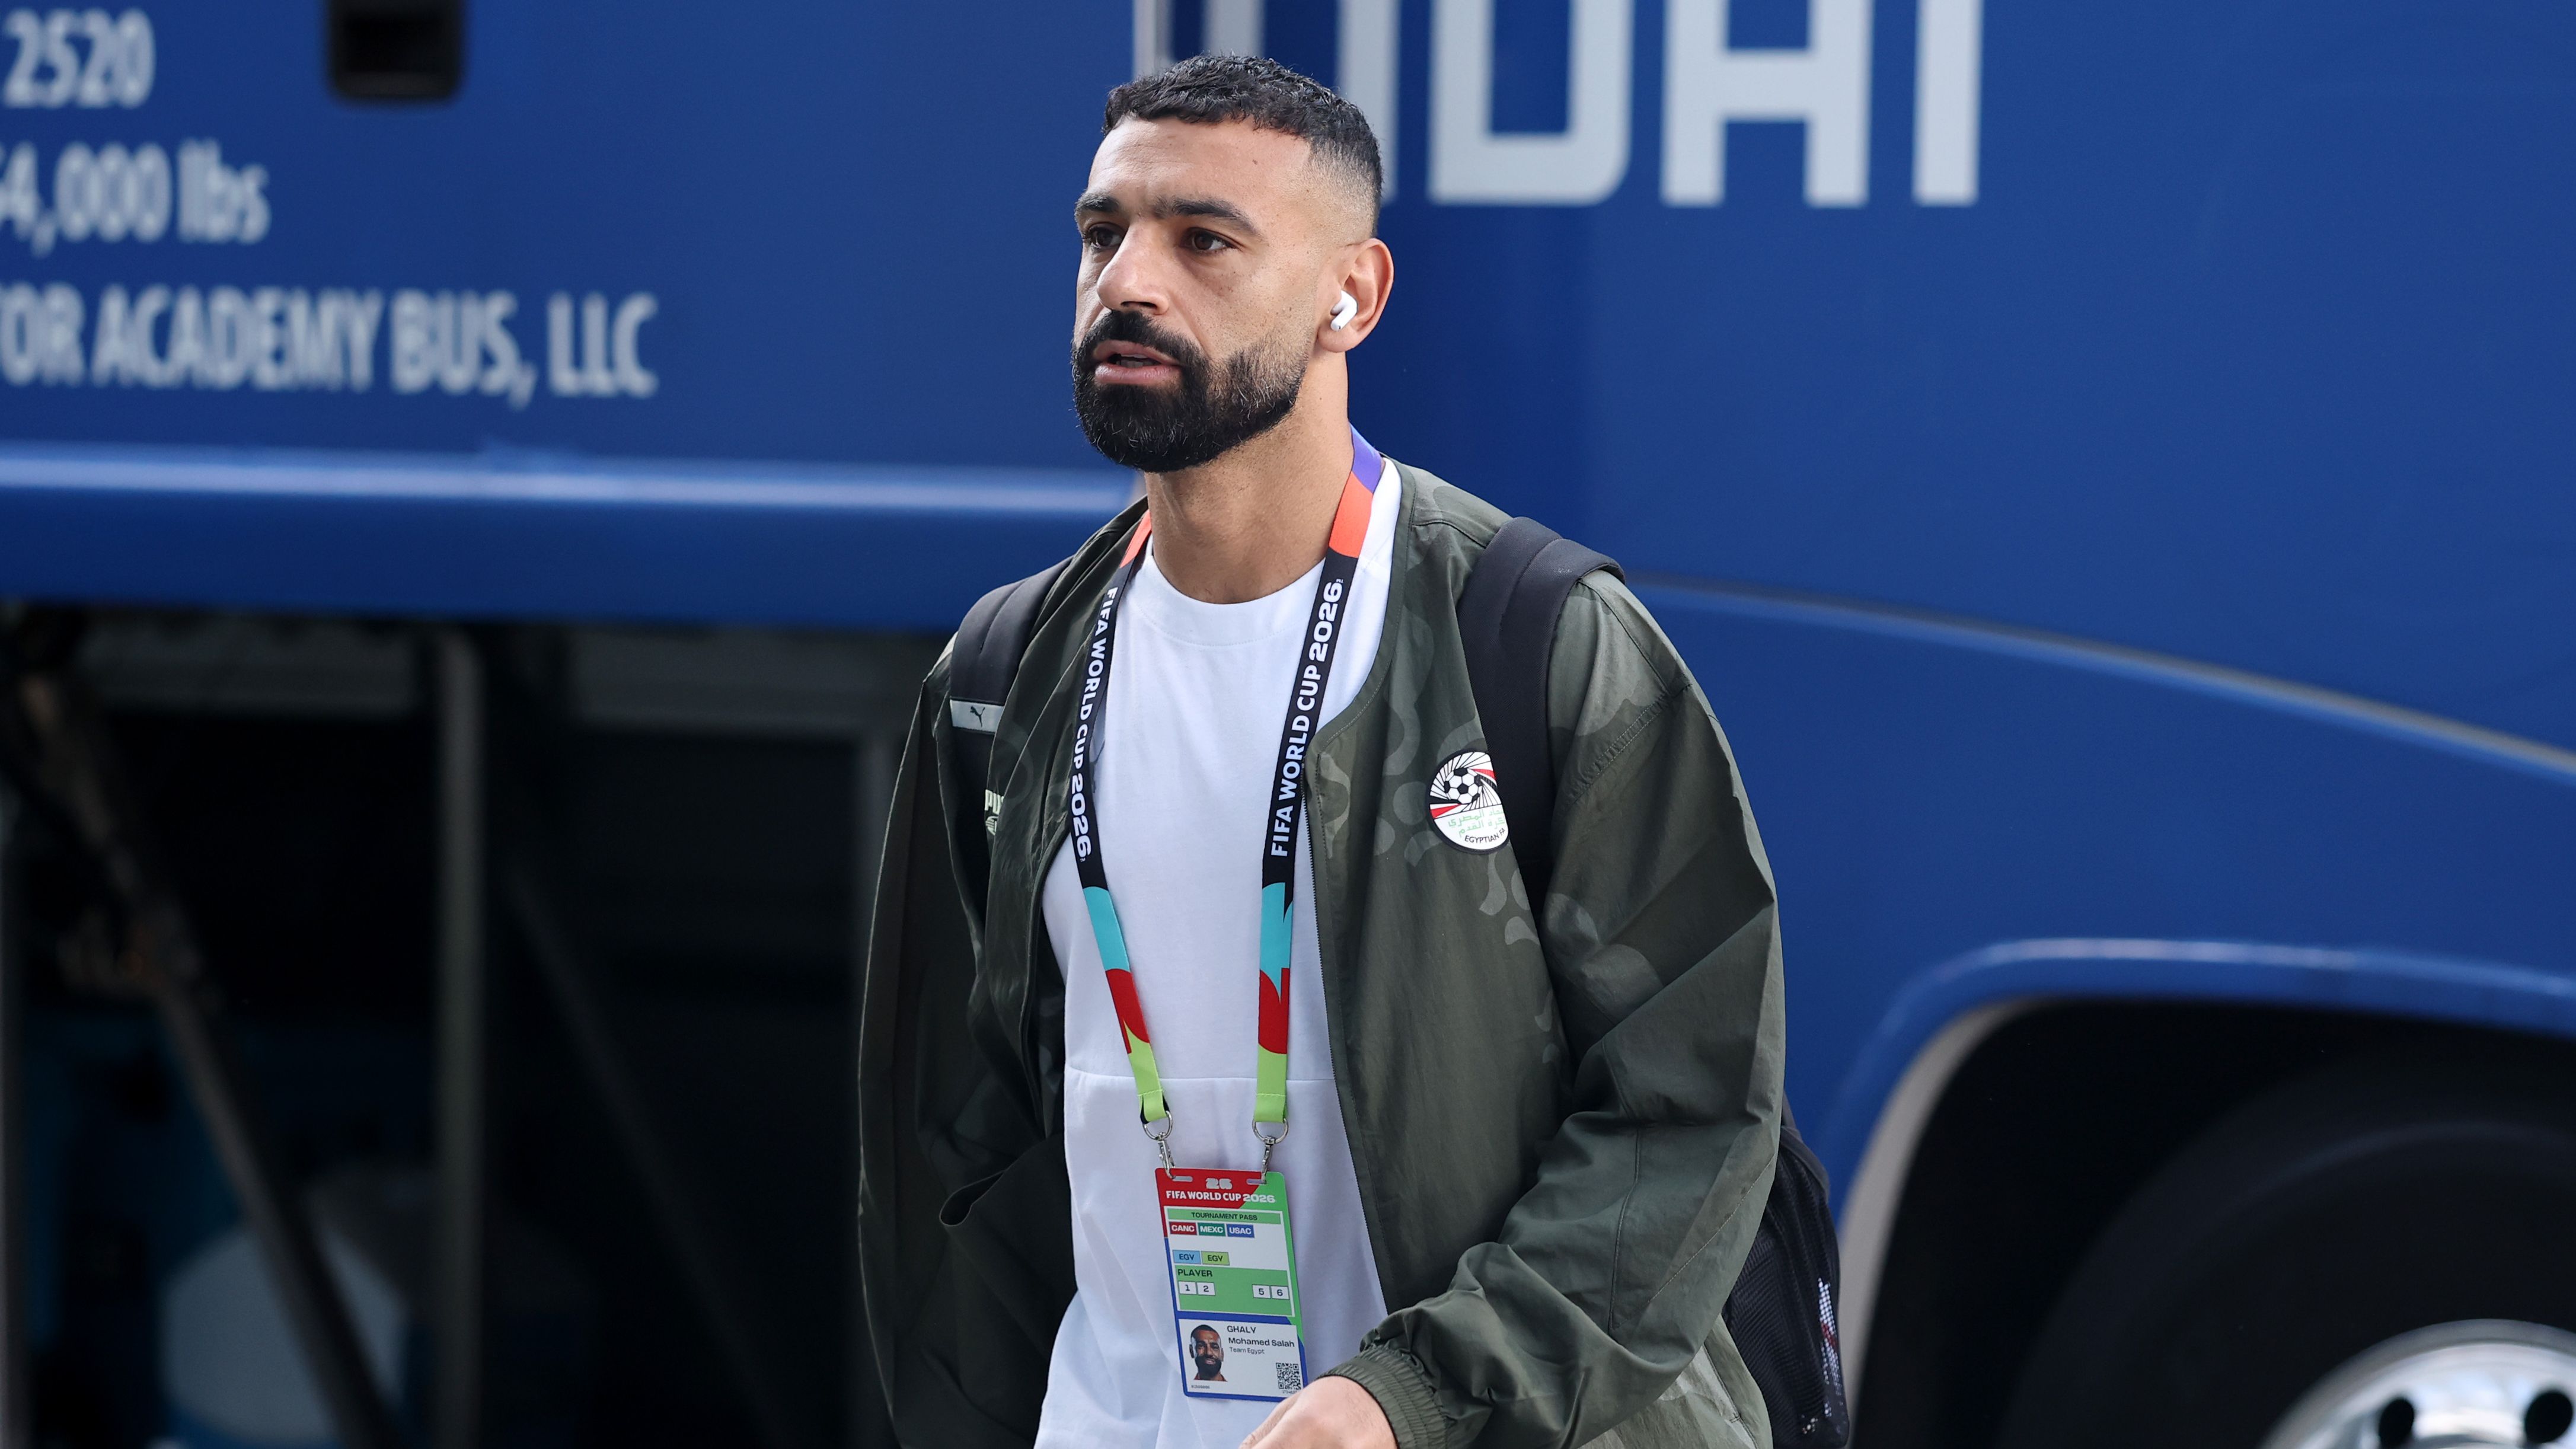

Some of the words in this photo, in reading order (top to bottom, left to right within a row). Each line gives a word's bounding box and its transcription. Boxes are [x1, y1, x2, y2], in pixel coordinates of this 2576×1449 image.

[4, 10, 154, 107] 2520
[0, 145, 172, 256] 4,000
[179, 140, 269, 242] lbs
[92, 286, 382, 390] ACADEMY
[391, 290, 537, 409] BUS,
[548, 293, 658, 397] LLC
[1094, 586, 1119, 636] FIFA
[1080, 637, 1107, 720] WORLD
[1297, 665, 1321, 711] CUP
[1073, 724, 1088, 769] CUP
[1279, 715, 1310, 800] WORLD
[1271, 806, 1294, 856] FIFA
[1464, 832, 1499, 843] EGYPTIAN
[1166, 1191, 1187, 1199] FIFA
[1187, 1191, 1221, 1201] WORLD
[1223, 1193, 1241, 1201] CUP
[1243, 1193, 1275, 1203] 2026
[1177, 1269, 1213, 1277] PLAYER
[1227, 1325, 1256, 1333] GHALY
[1228, 1338, 1270, 1346] Mohamed
